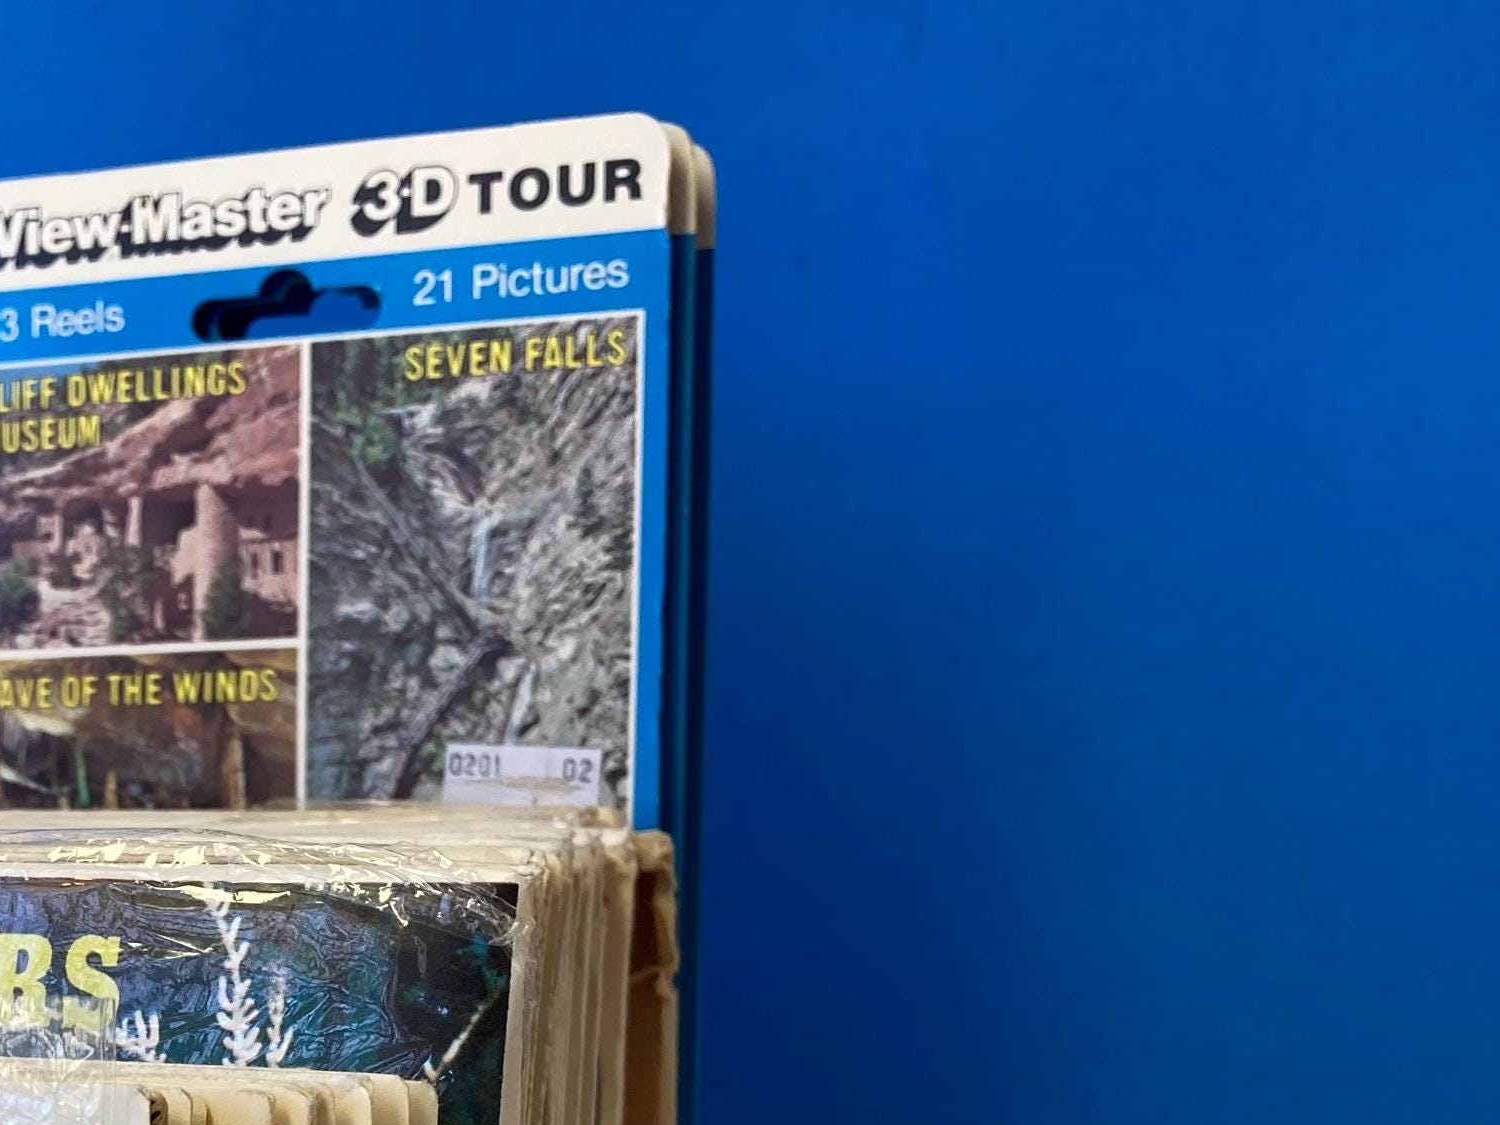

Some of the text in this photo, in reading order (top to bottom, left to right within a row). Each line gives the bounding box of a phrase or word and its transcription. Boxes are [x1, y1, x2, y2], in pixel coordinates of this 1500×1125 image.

[468, 158, 643, 215] TOUR
[412, 258, 630, 306] 21 Pictures
[30, 300, 125, 338] Reels
[404, 329, 627, 382] SEVEN FALLS
[66, 360, 246, 408] DWELLINGS
[61, 675, 99, 708] OF
[106, 672, 164, 706] THE
[172, 668, 279, 704] WINDS
